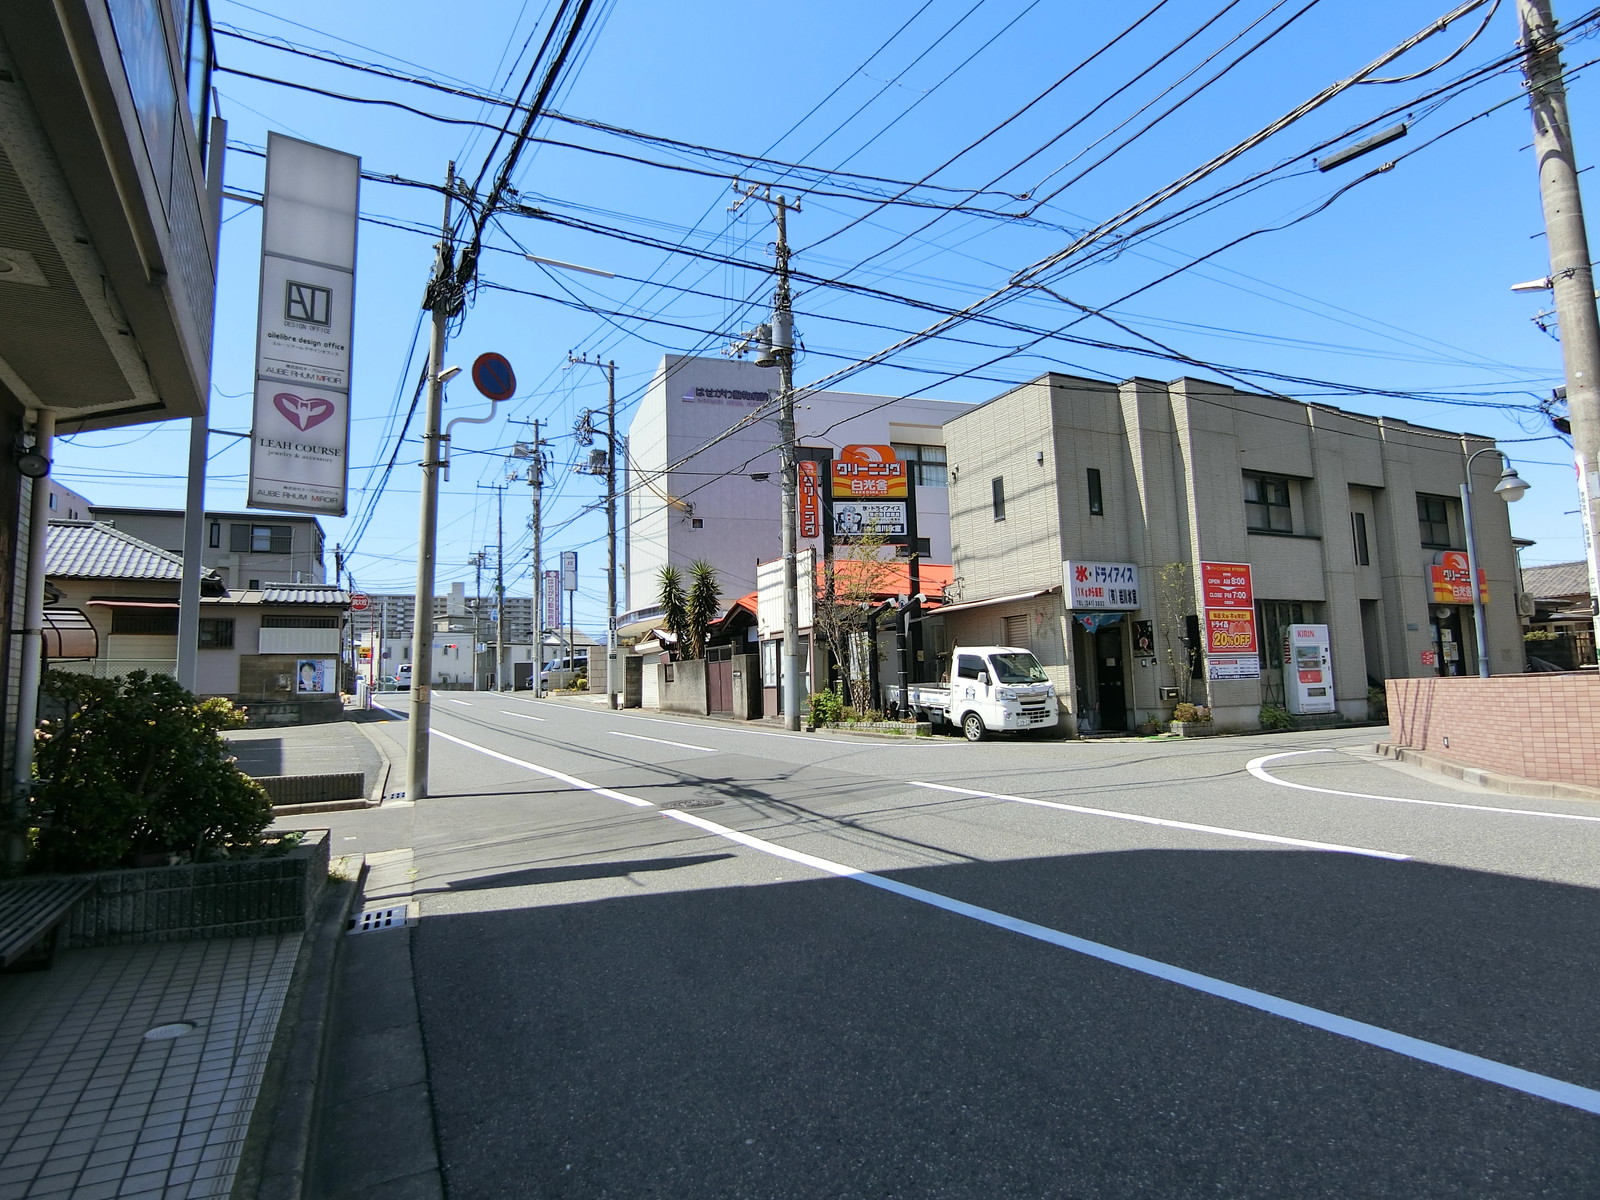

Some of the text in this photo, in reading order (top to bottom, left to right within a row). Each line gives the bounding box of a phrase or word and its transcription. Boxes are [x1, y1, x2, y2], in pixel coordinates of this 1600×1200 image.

[284, 321, 332, 335] DESIGN OFFICE
[298, 337, 322, 347] design
[323, 342, 345, 351] office
[266, 366, 342, 384] AUBE RHUM MIROIR
[260, 438, 342, 457] LEAH COURSE
[836, 462, 901, 476] クリーニング
[256, 489, 338, 504] AUBE RHUM MIROIR
[803, 476, 815, 536] クリーニング
[1231, 577, 1246, 586] 8:00
[1443, 568, 1472, 582] クリーニン
[1232, 591, 1247, 599] 7:00
[1212, 631, 1252, 647] 20%OFF
[1297, 630, 1315, 638] KIRIN
[1282, 636, 1292, 665] KIRIN
